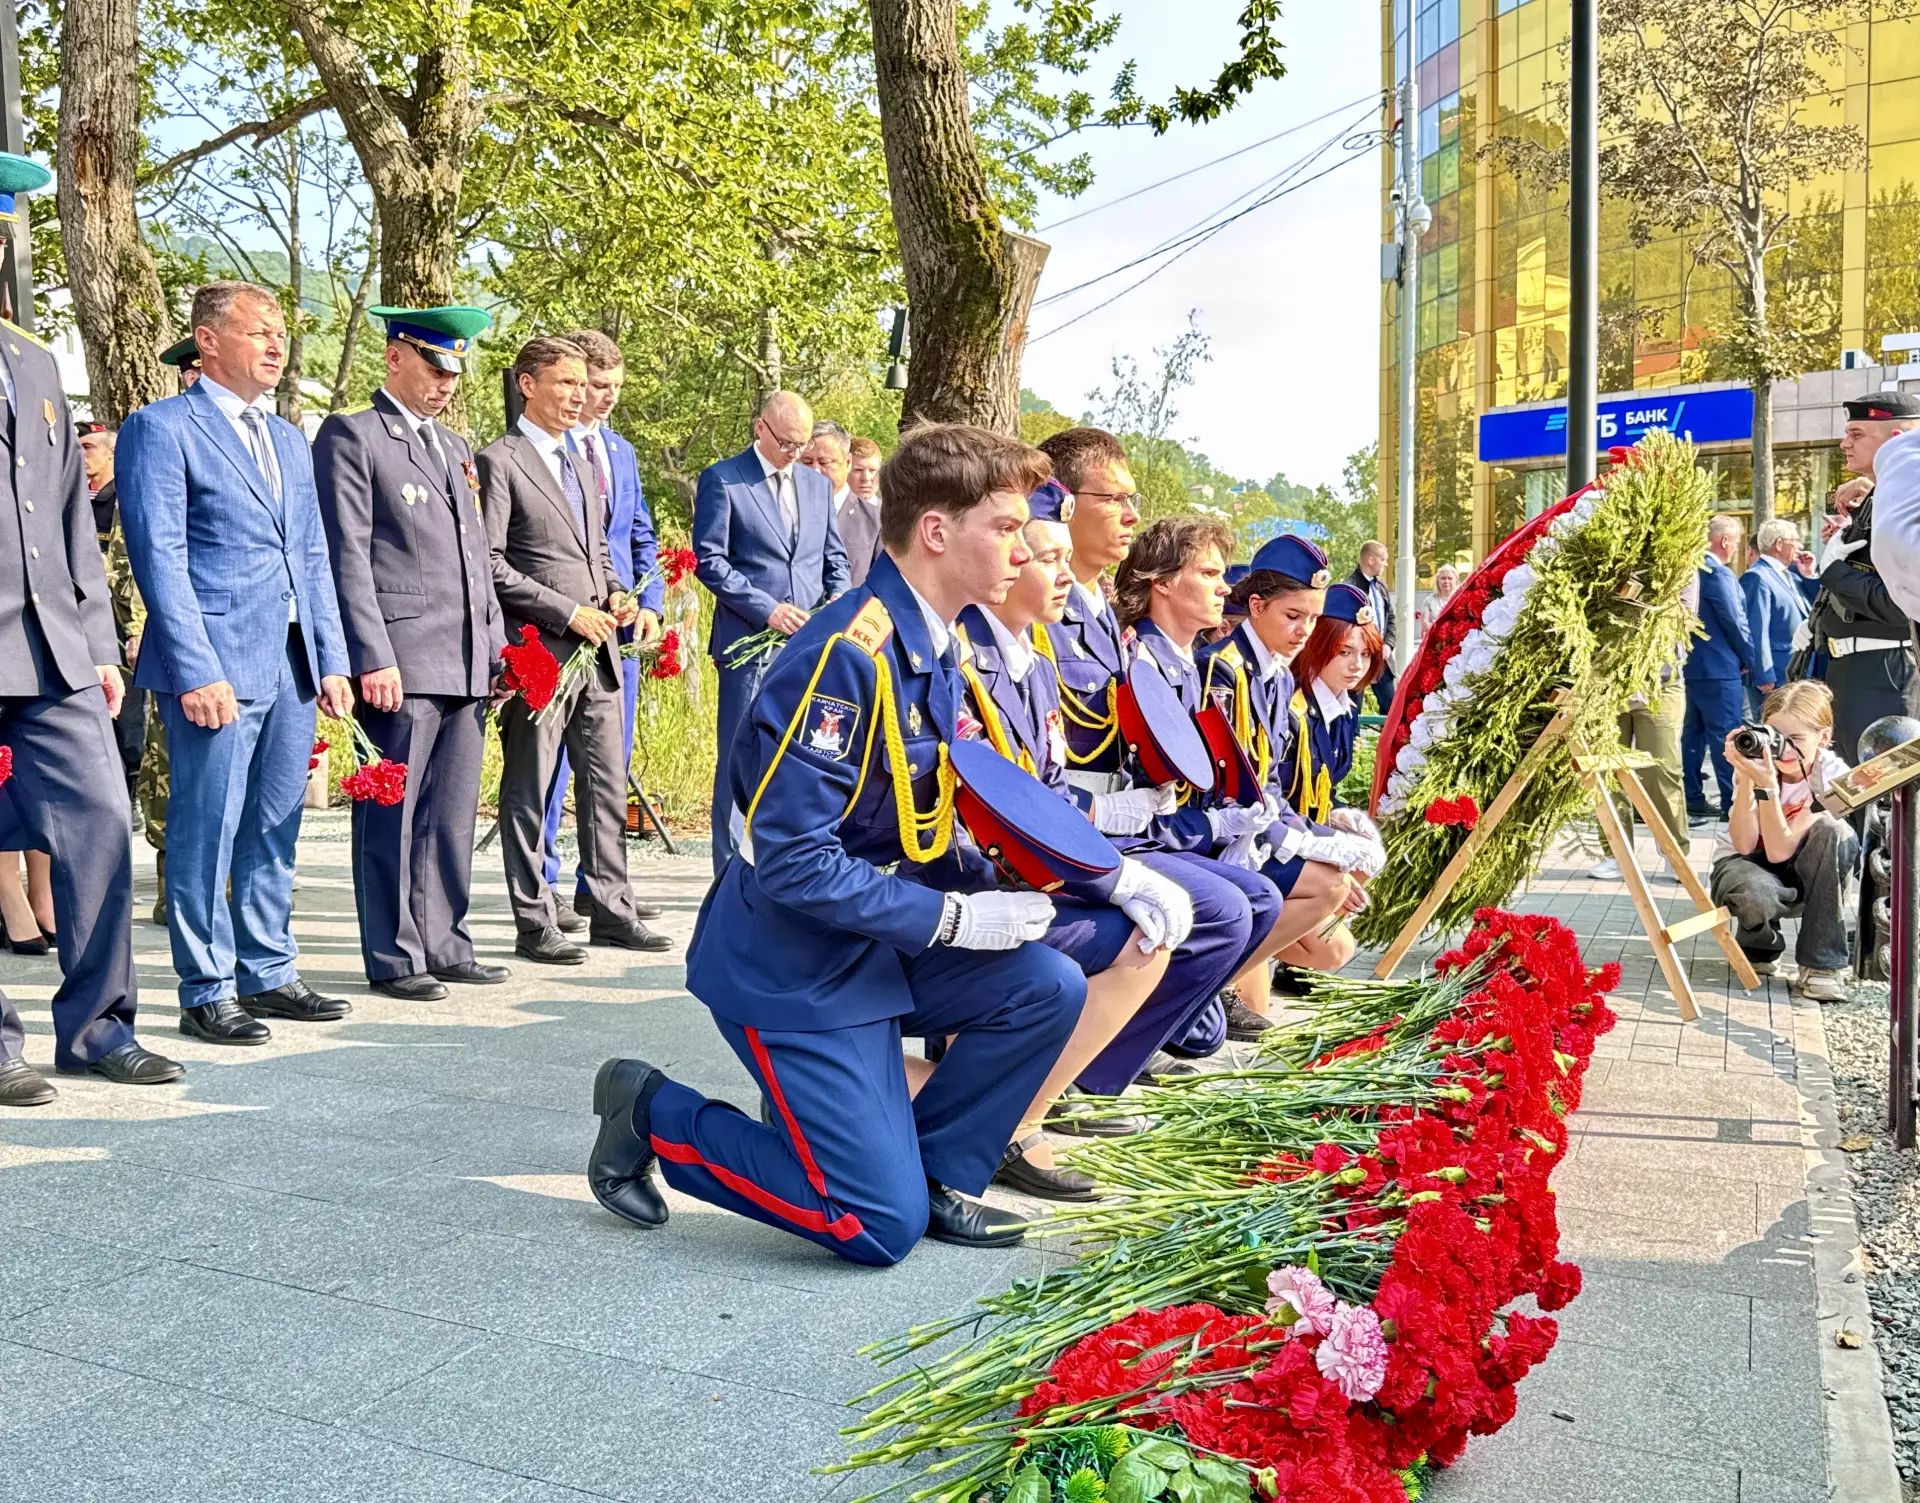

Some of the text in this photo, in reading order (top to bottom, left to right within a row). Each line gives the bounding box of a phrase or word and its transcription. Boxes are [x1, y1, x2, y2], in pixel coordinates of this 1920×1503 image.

[1625, 408, 1668, 425] БАНК
[852, 628, 874, 647] КК
[811, 697, 858, 714] КАМЧАТСКИЙ
[824, 705, 844, 714] КРАЙ
